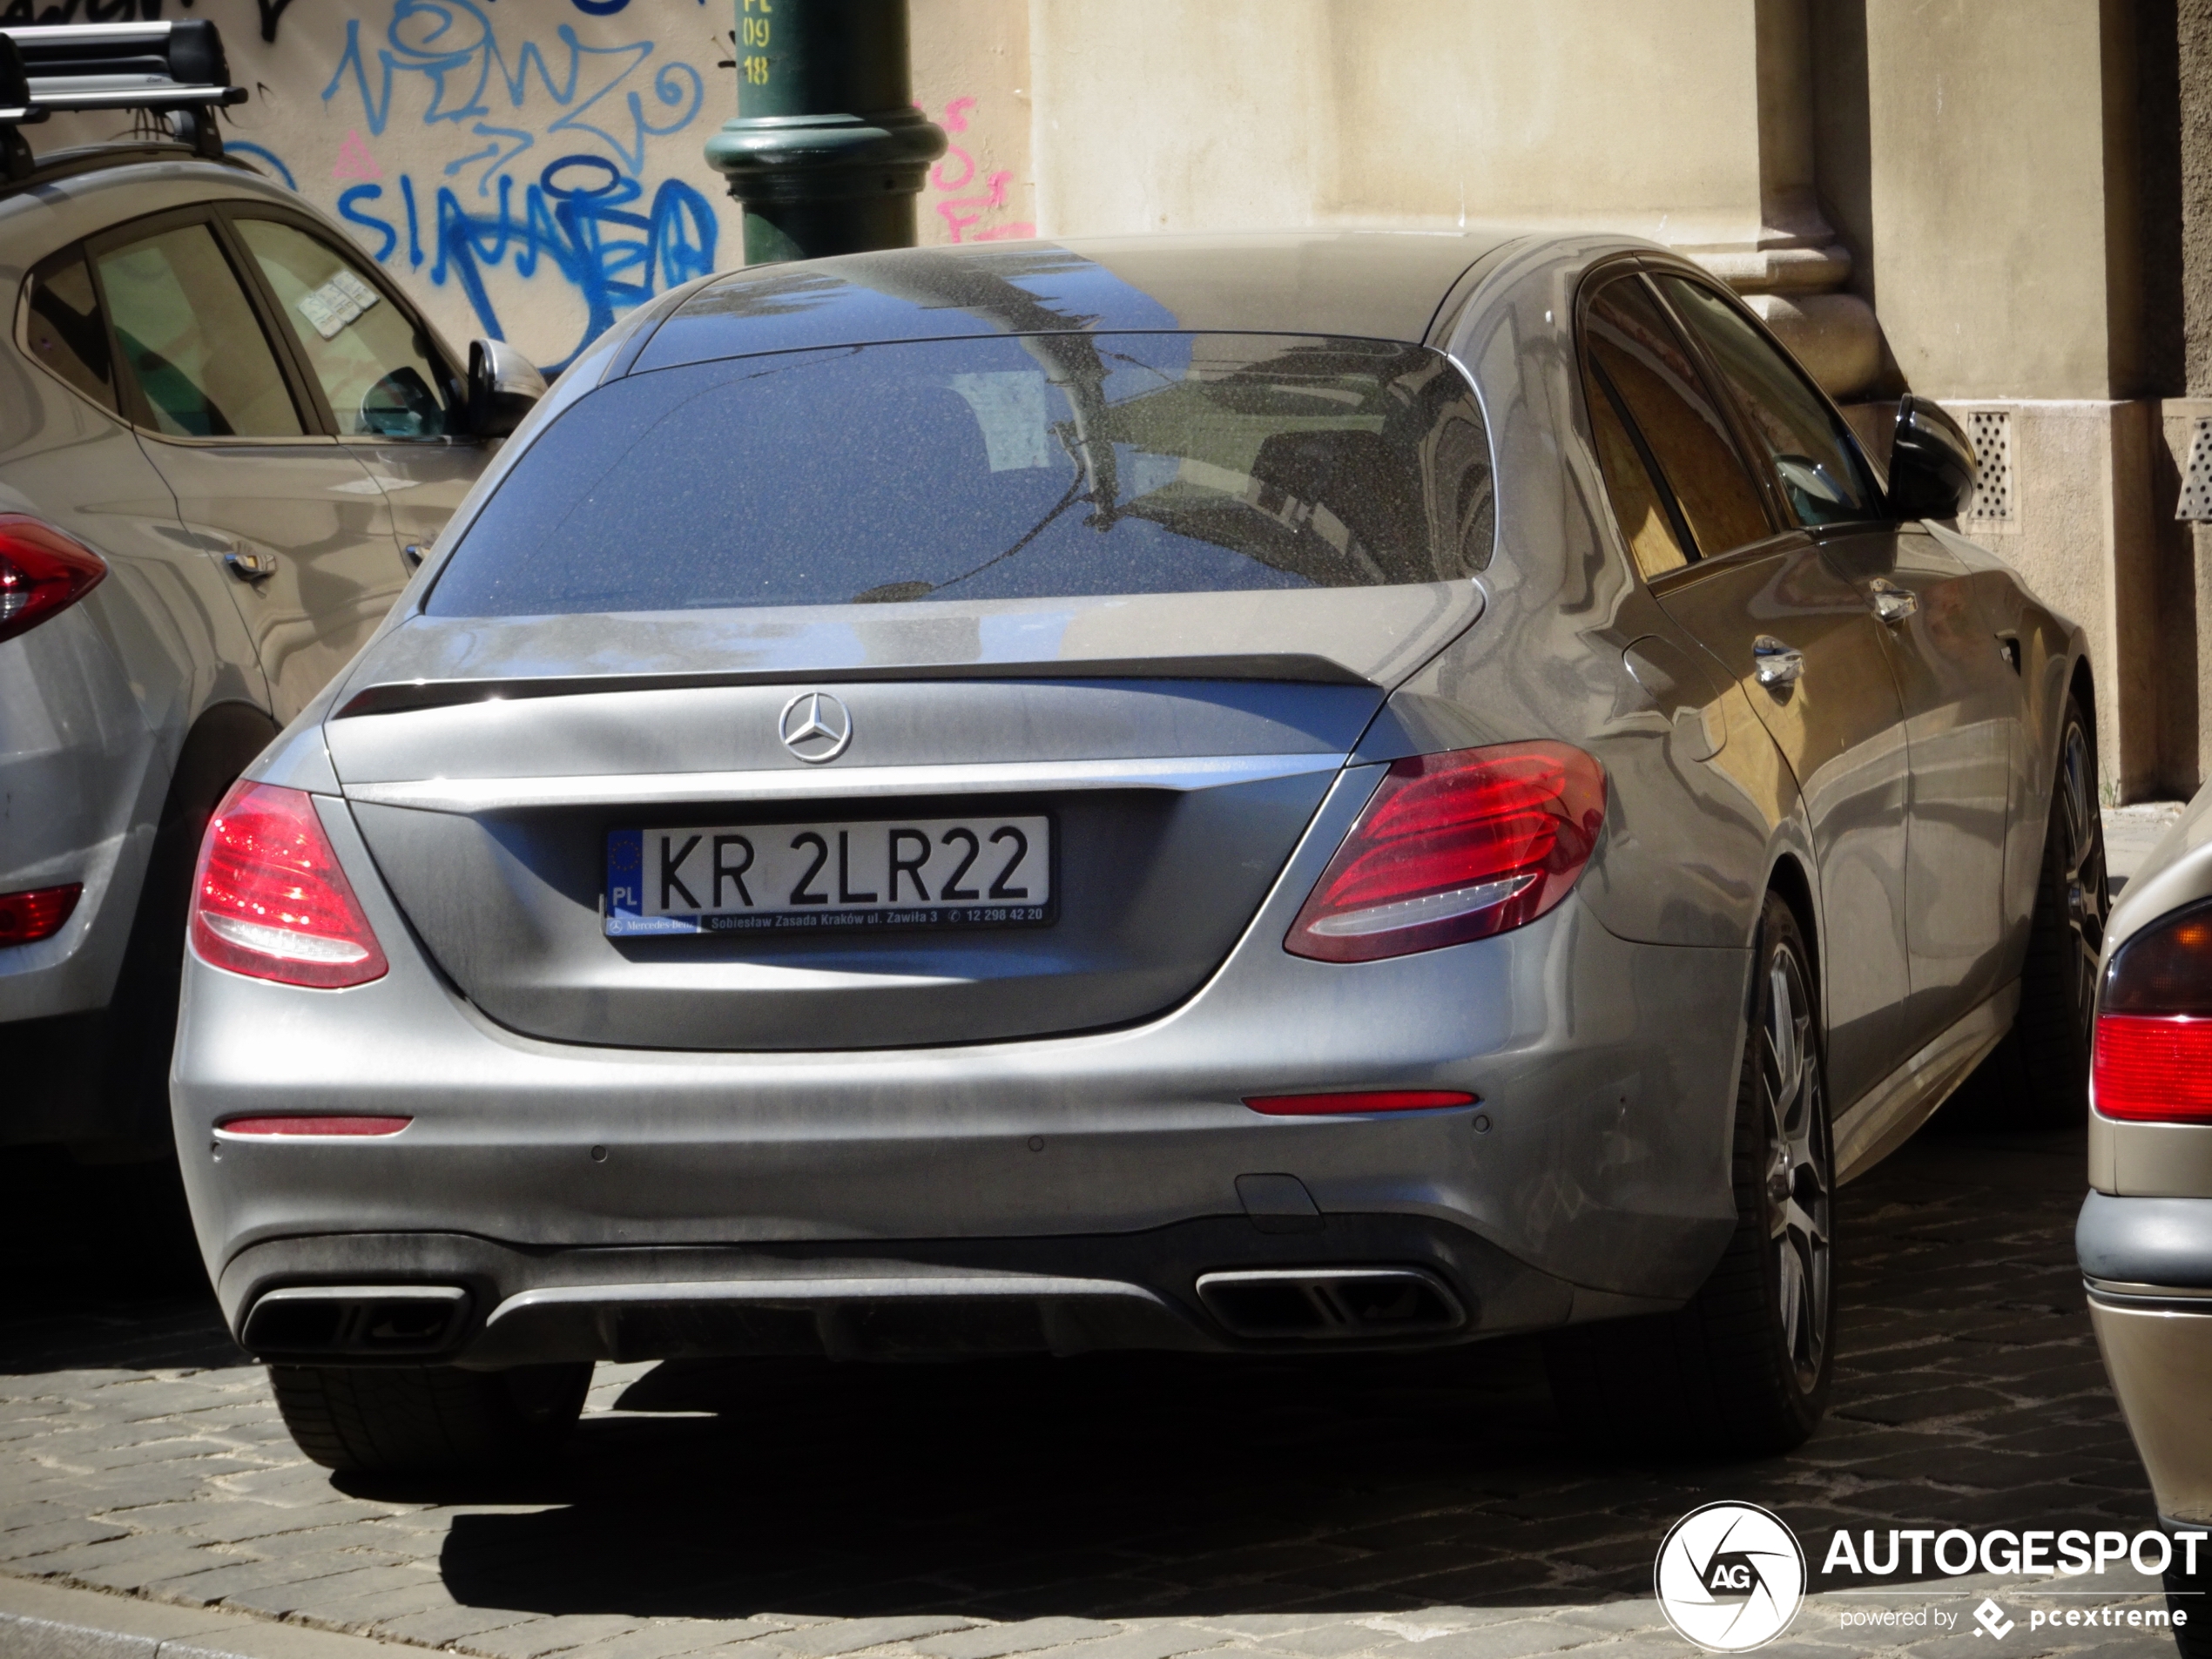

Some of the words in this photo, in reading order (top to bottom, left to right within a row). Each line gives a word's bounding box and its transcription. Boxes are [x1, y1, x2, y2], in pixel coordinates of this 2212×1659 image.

[743, 17, 770, 47] 09
[744, 55, 769, 85] 18
[659, 834, 755, 910] KR
[788, 825, 1029, 907] 2LR22
[612, 886, 637, 907] PL
[626, 917, 694, 931] Mercedes-Benz
[711, 916, 772, 929] Sobiesław
[775, 914, 817, 927] Zasada
[820, 912, 863, 926] Kraków
[867, 912, 882, 924] ul.
[887, 911, 927, 923] Zawiła
[930, 911, 938, 922] 3
[967, 910, 981, 921] 12
[984, 909, 1006, 921] 298
[1009, 908, 1024, 920] 42
[1028, 907, 1042, 920] 20
